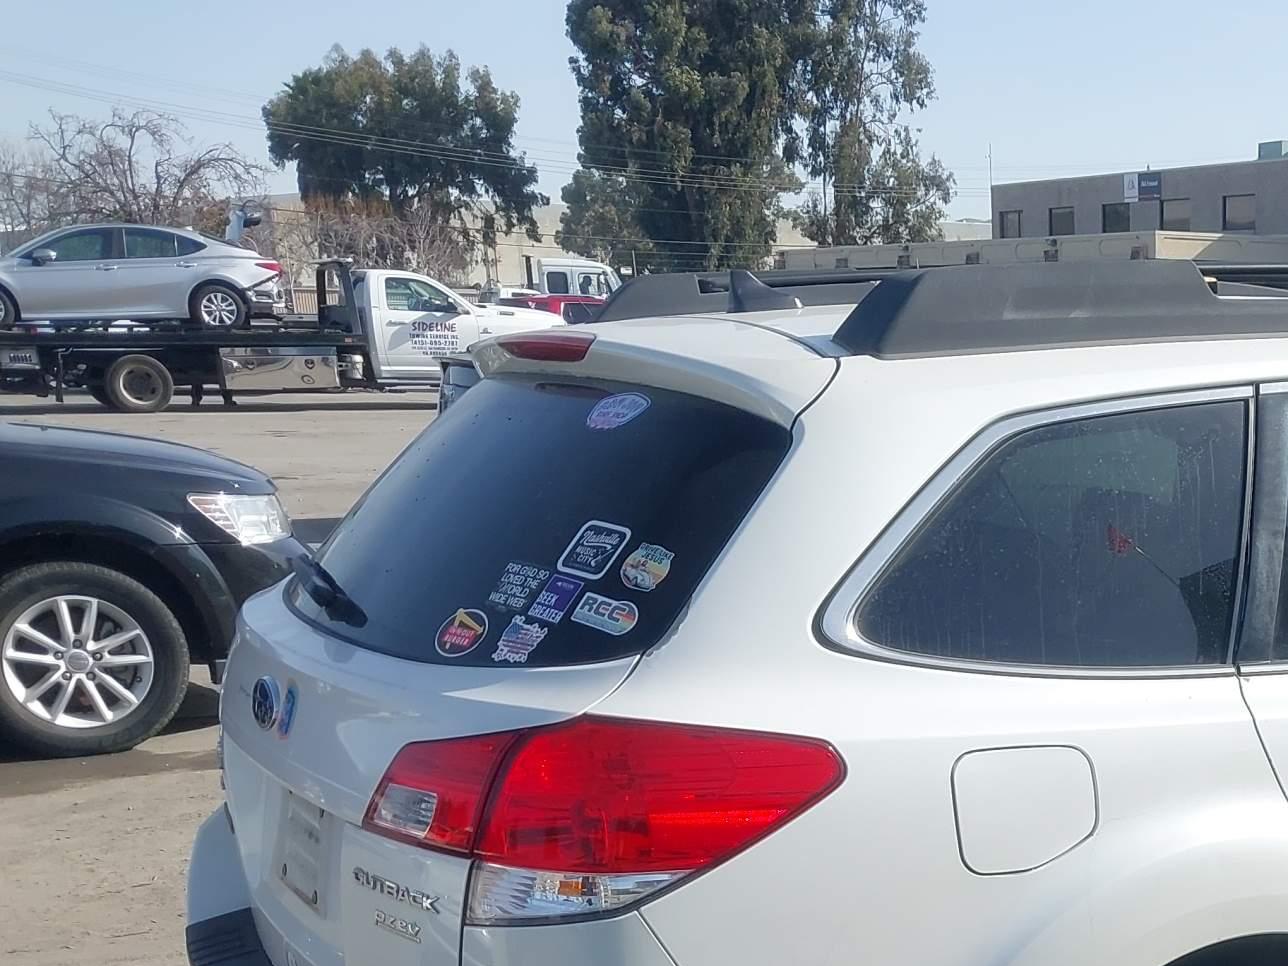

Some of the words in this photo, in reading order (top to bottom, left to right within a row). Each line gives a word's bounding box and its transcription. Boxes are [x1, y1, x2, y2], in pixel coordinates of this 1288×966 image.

[411, 321, 457, 332] SIDELINE
[580, 530, 620, 546] Nashville
[576, 545, 597, 556] MUSIC
[641, 551, 664, 565] JESUS
[577, 555, 595, 564] CITY
[505, 563, 521, 574] FOR
[536, 569, 550, 580] SO
[501, 573, 526, 585] LOVED
[524, 577, 541, 589] THE
[489, 592, 508, 604] WIDE
[537, 591, 560, 607] SEEK
[528, 604, 563, 624] GREATER
[353, 866, 440, 914] OUTBACK
